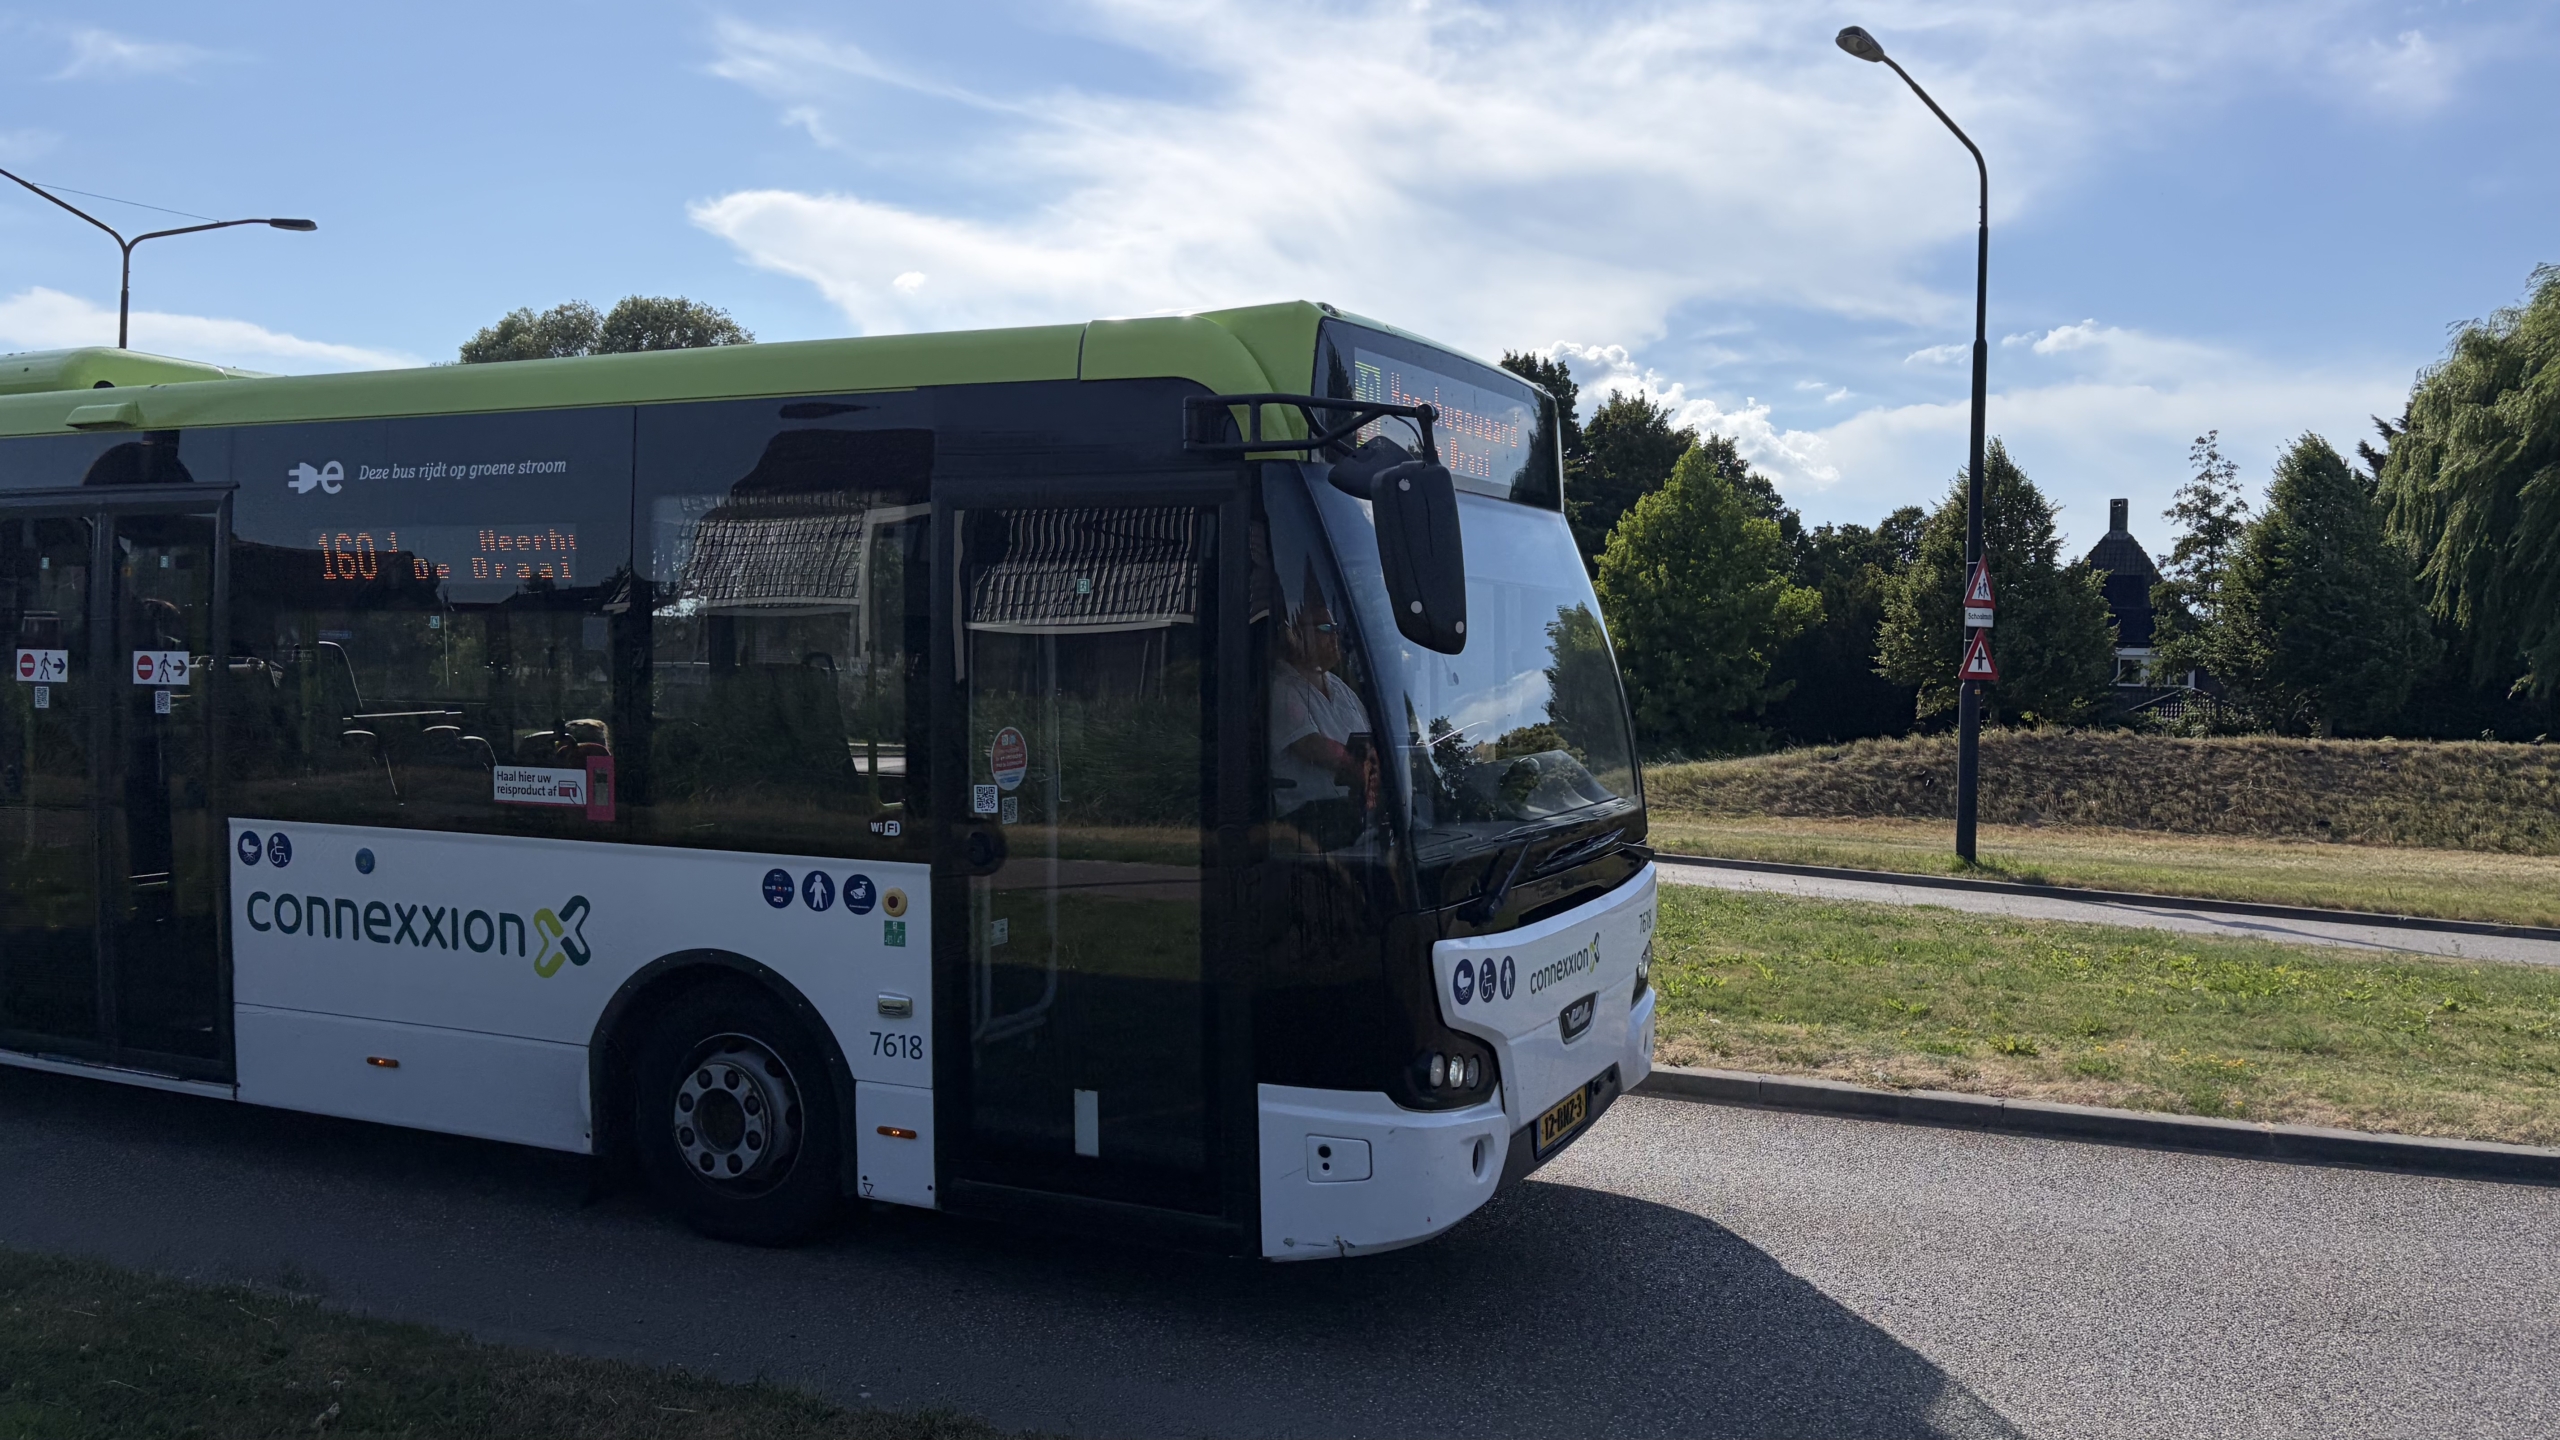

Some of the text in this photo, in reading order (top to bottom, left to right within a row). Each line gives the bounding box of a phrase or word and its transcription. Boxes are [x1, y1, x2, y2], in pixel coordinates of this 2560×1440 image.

[359, 459, 567, 481] Deze bus rijdt op groene stroom
[317, 533, 378, 580] 160
[471, 556, 572, 579] Draai
[497, 771, 552, 784] Haal hier uw
[497, 783, 558, 798] reisproduct af
[247, 891, 526, 957] connexxion
[1530, 947, 1589, 995] connexxion
[1565, 1000, 1592, 1030] VDL
[869, 1031, 923, 1060] 7618
